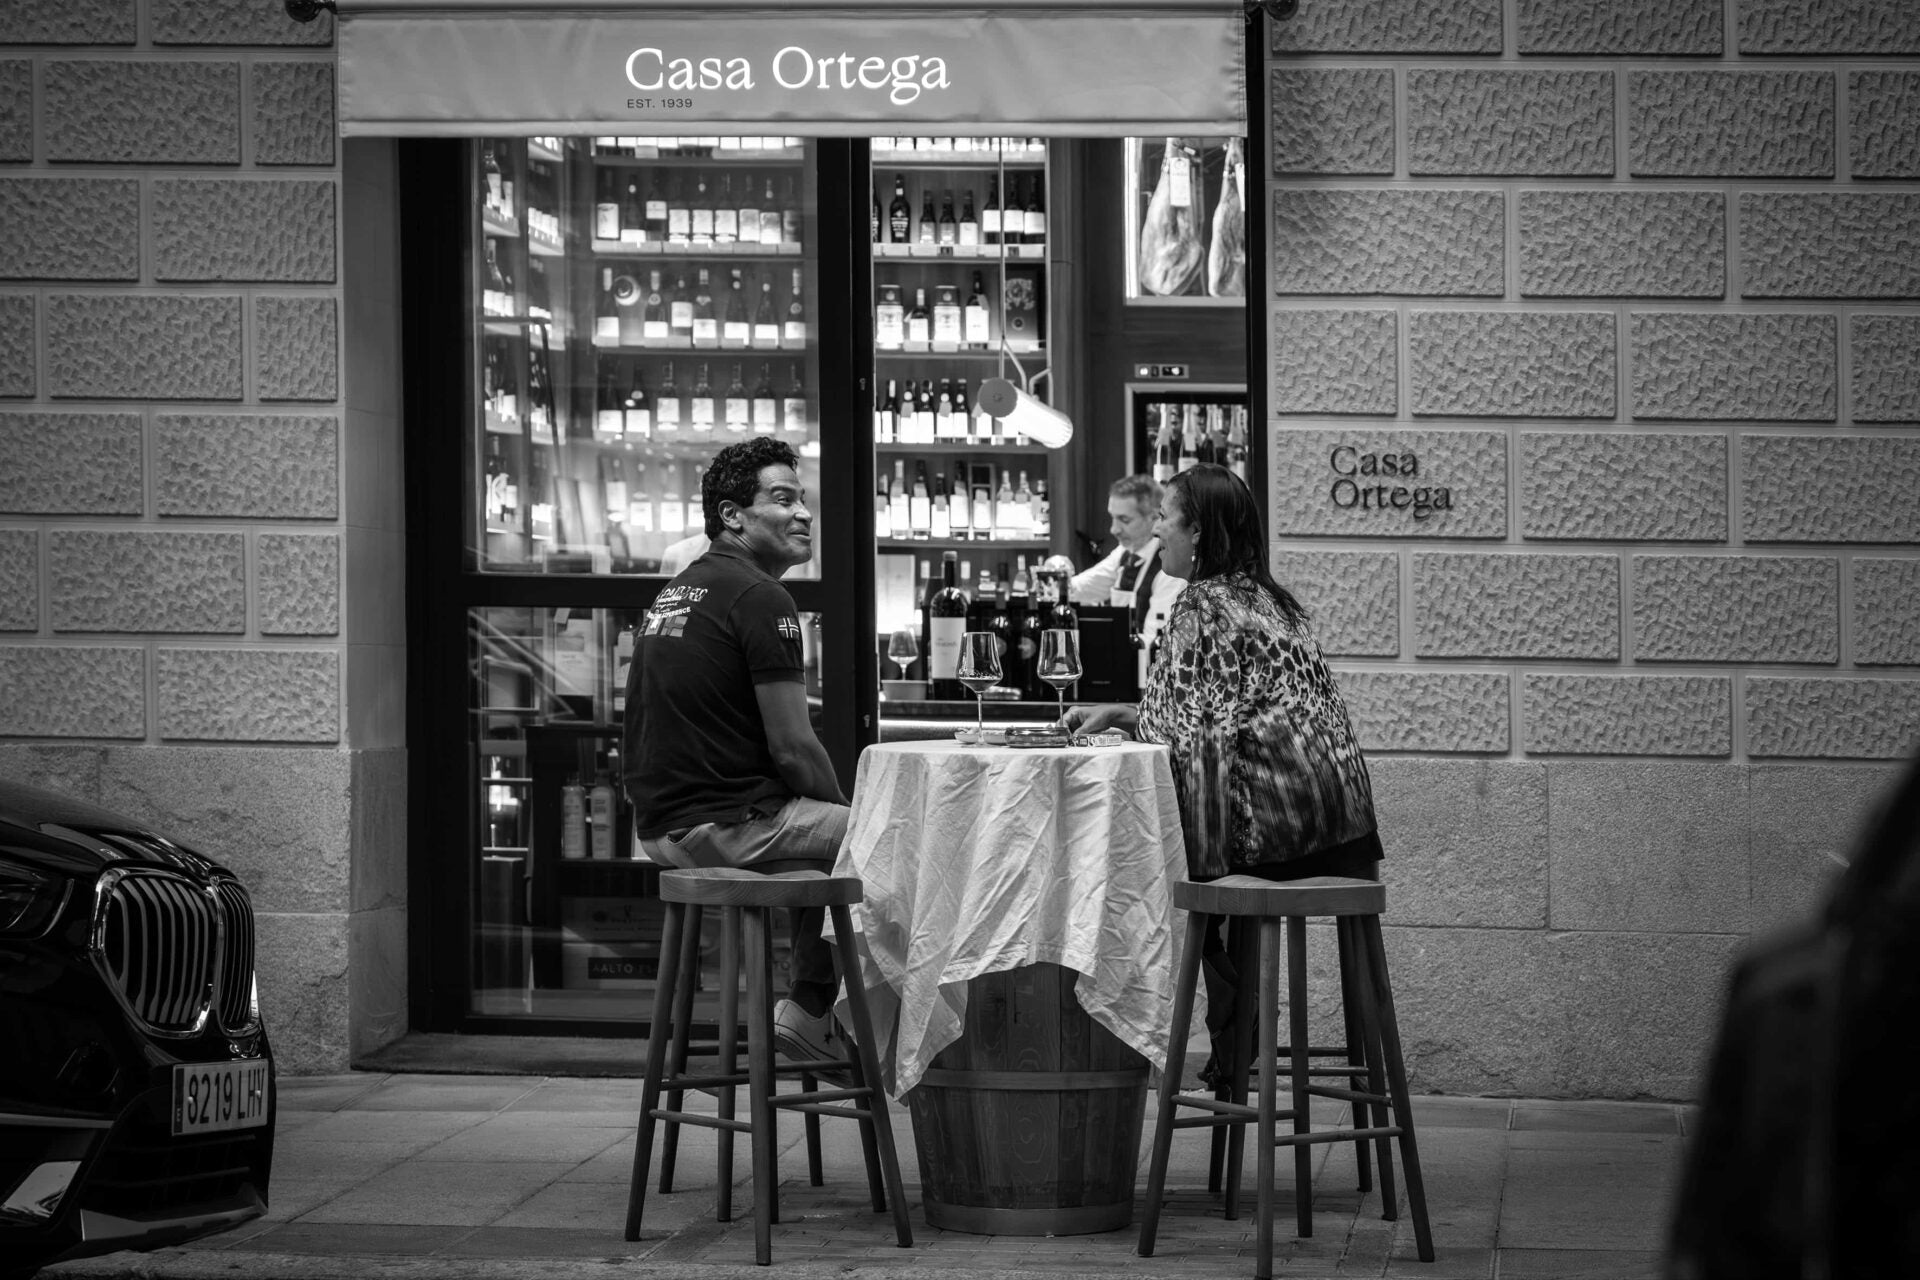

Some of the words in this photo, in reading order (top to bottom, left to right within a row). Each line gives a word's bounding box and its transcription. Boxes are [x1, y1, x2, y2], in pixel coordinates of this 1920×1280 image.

[625, 47, 755, 90] Casa
[772, 46, 950, 105] Ortega
[626, 98, 655, 109] EST.
[661, 98, 693, 108] 1939
[1330, 445, 1418, 476] Casa
[1330, 479, 1453, 521] Ortega
[592, 963, 634, 974] AALTO
[187, 1072, 233, 1125] 8219
[237, 1068, 265, 1119] LHY
